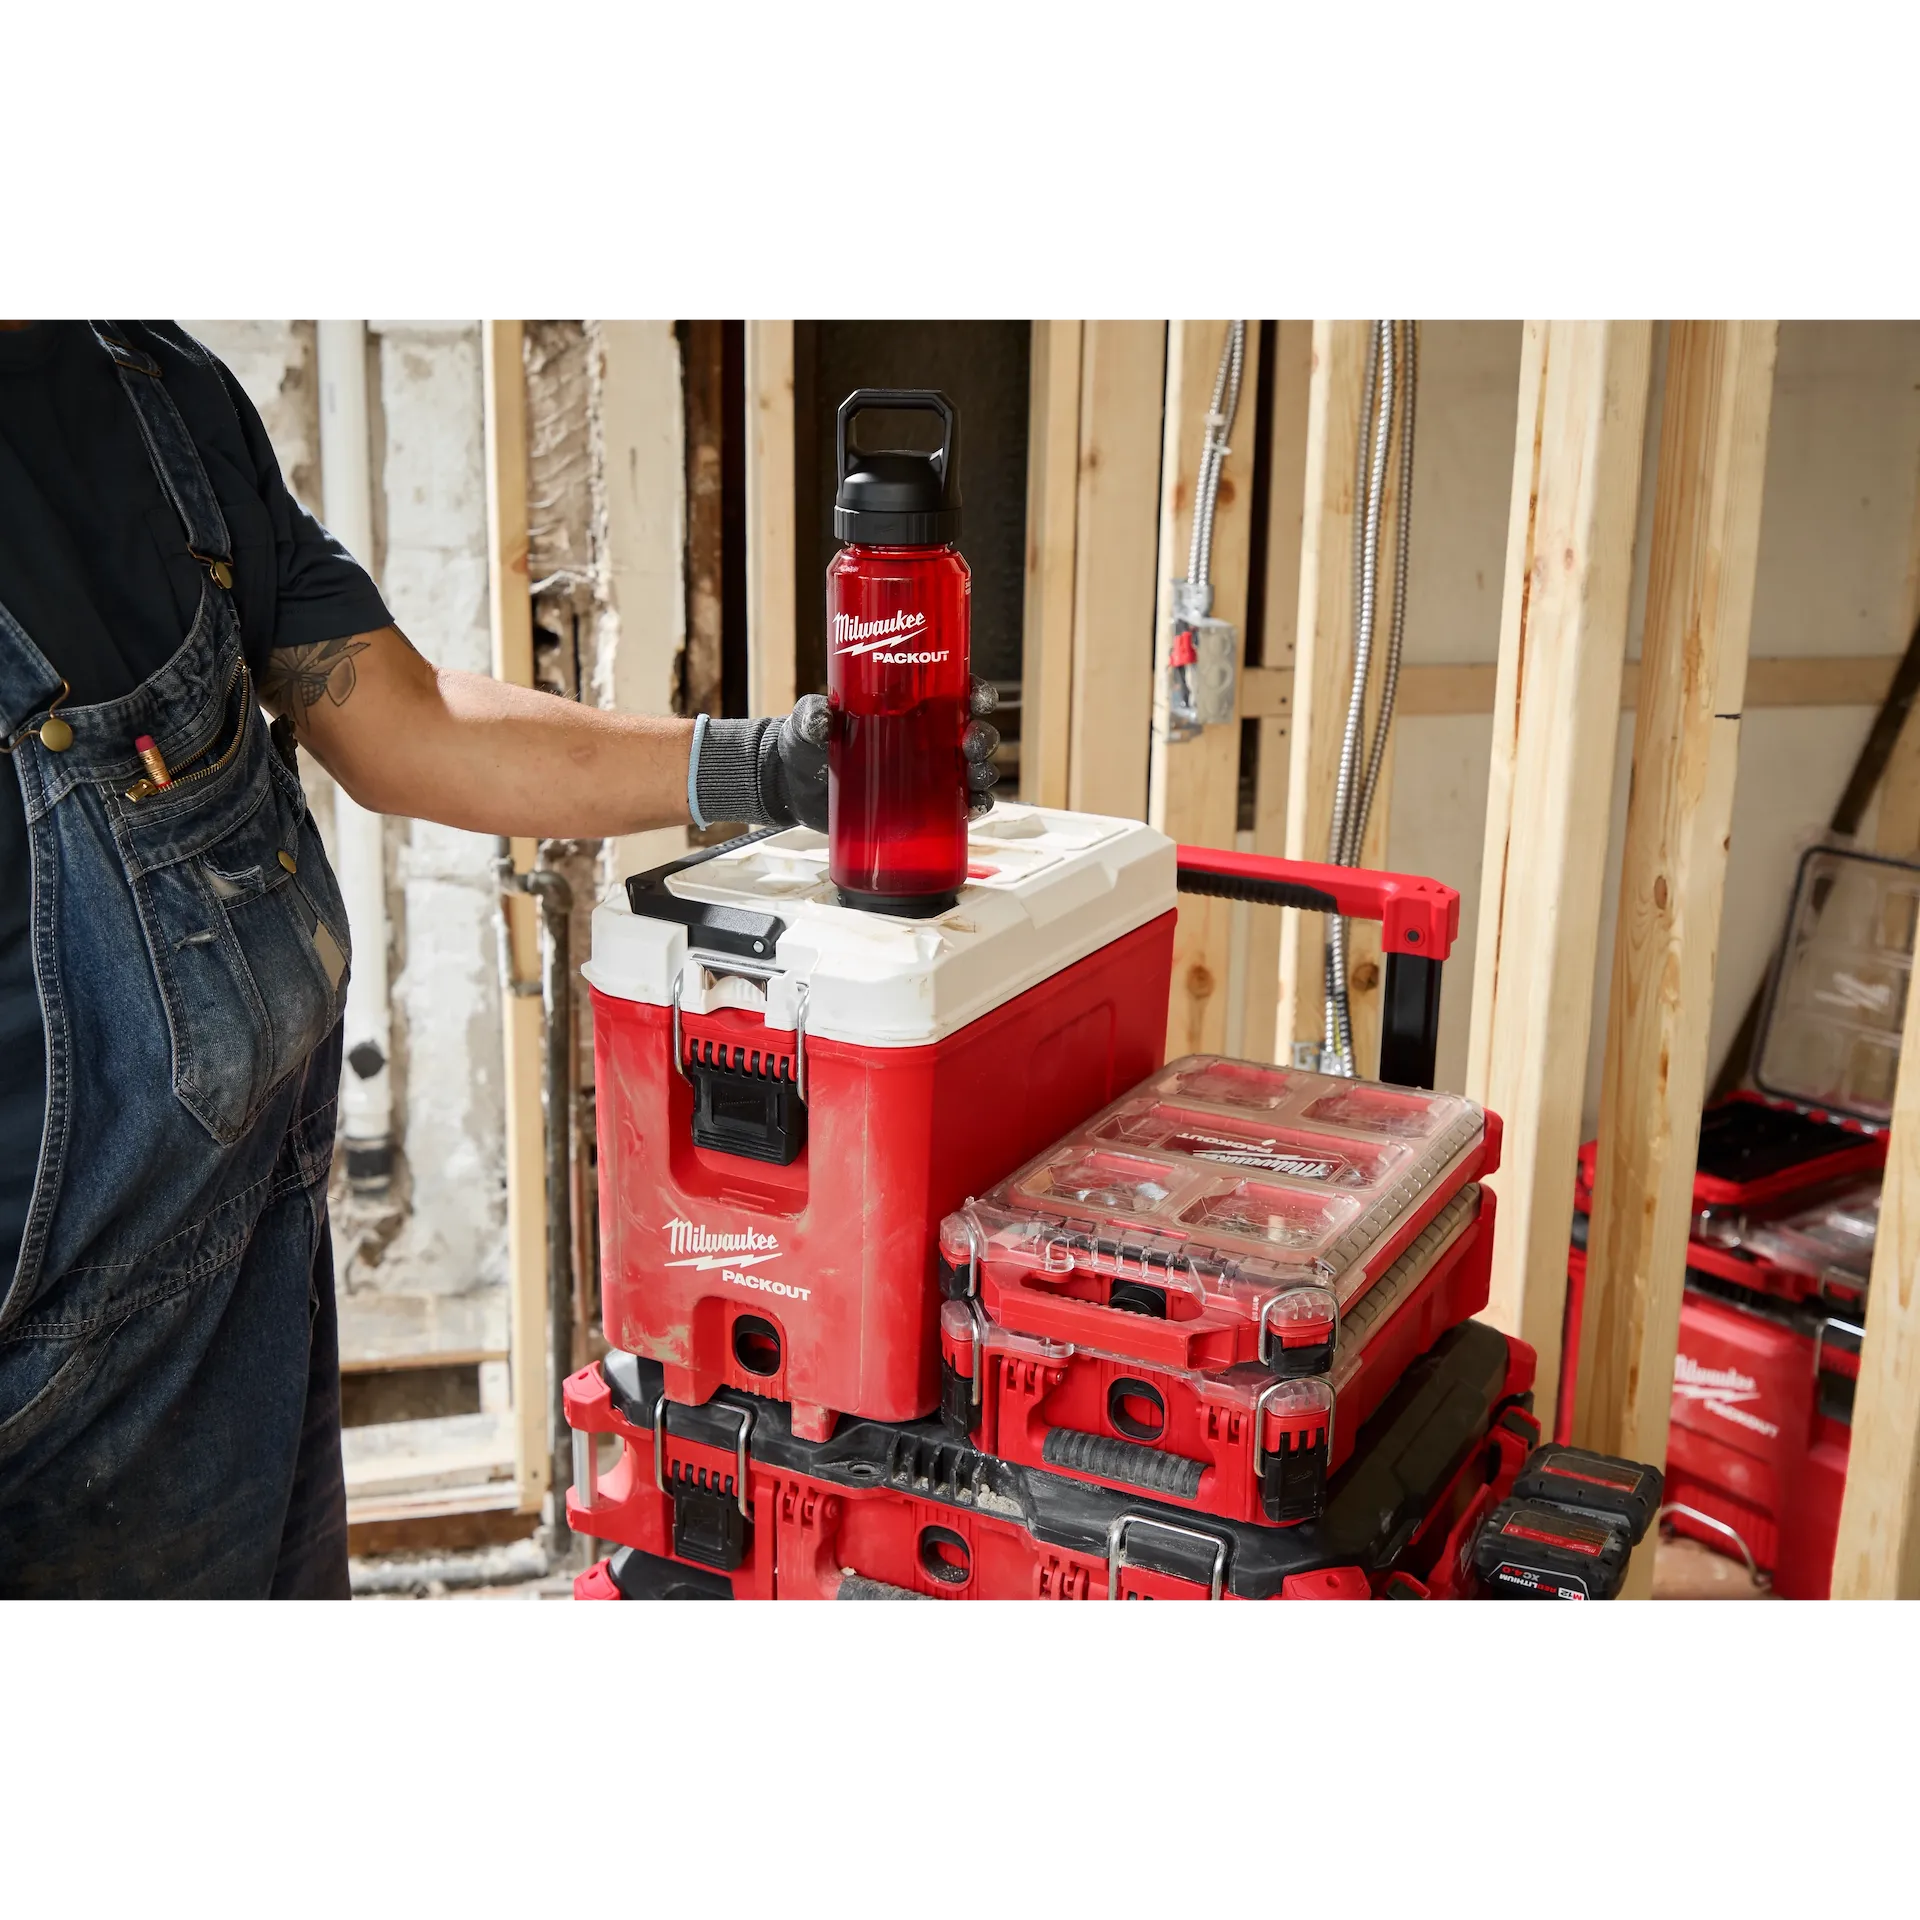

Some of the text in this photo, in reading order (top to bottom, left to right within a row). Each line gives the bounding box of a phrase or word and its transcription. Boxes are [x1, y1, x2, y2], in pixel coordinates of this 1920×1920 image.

[832, 610, 926, 645] Milwaukee
[872, 650, 950, 665] PACKOUT
[1176, 1132, 1274, 1154] PACKOUT
[662, 1216, 779, 1255] Milwaukee
[722, 1269, 811, 1301] PACKOUT
[1499, 1574, 1557, 1593] REDLITHIUM
[1502, 1566, 1540, 1582] XC4.0
